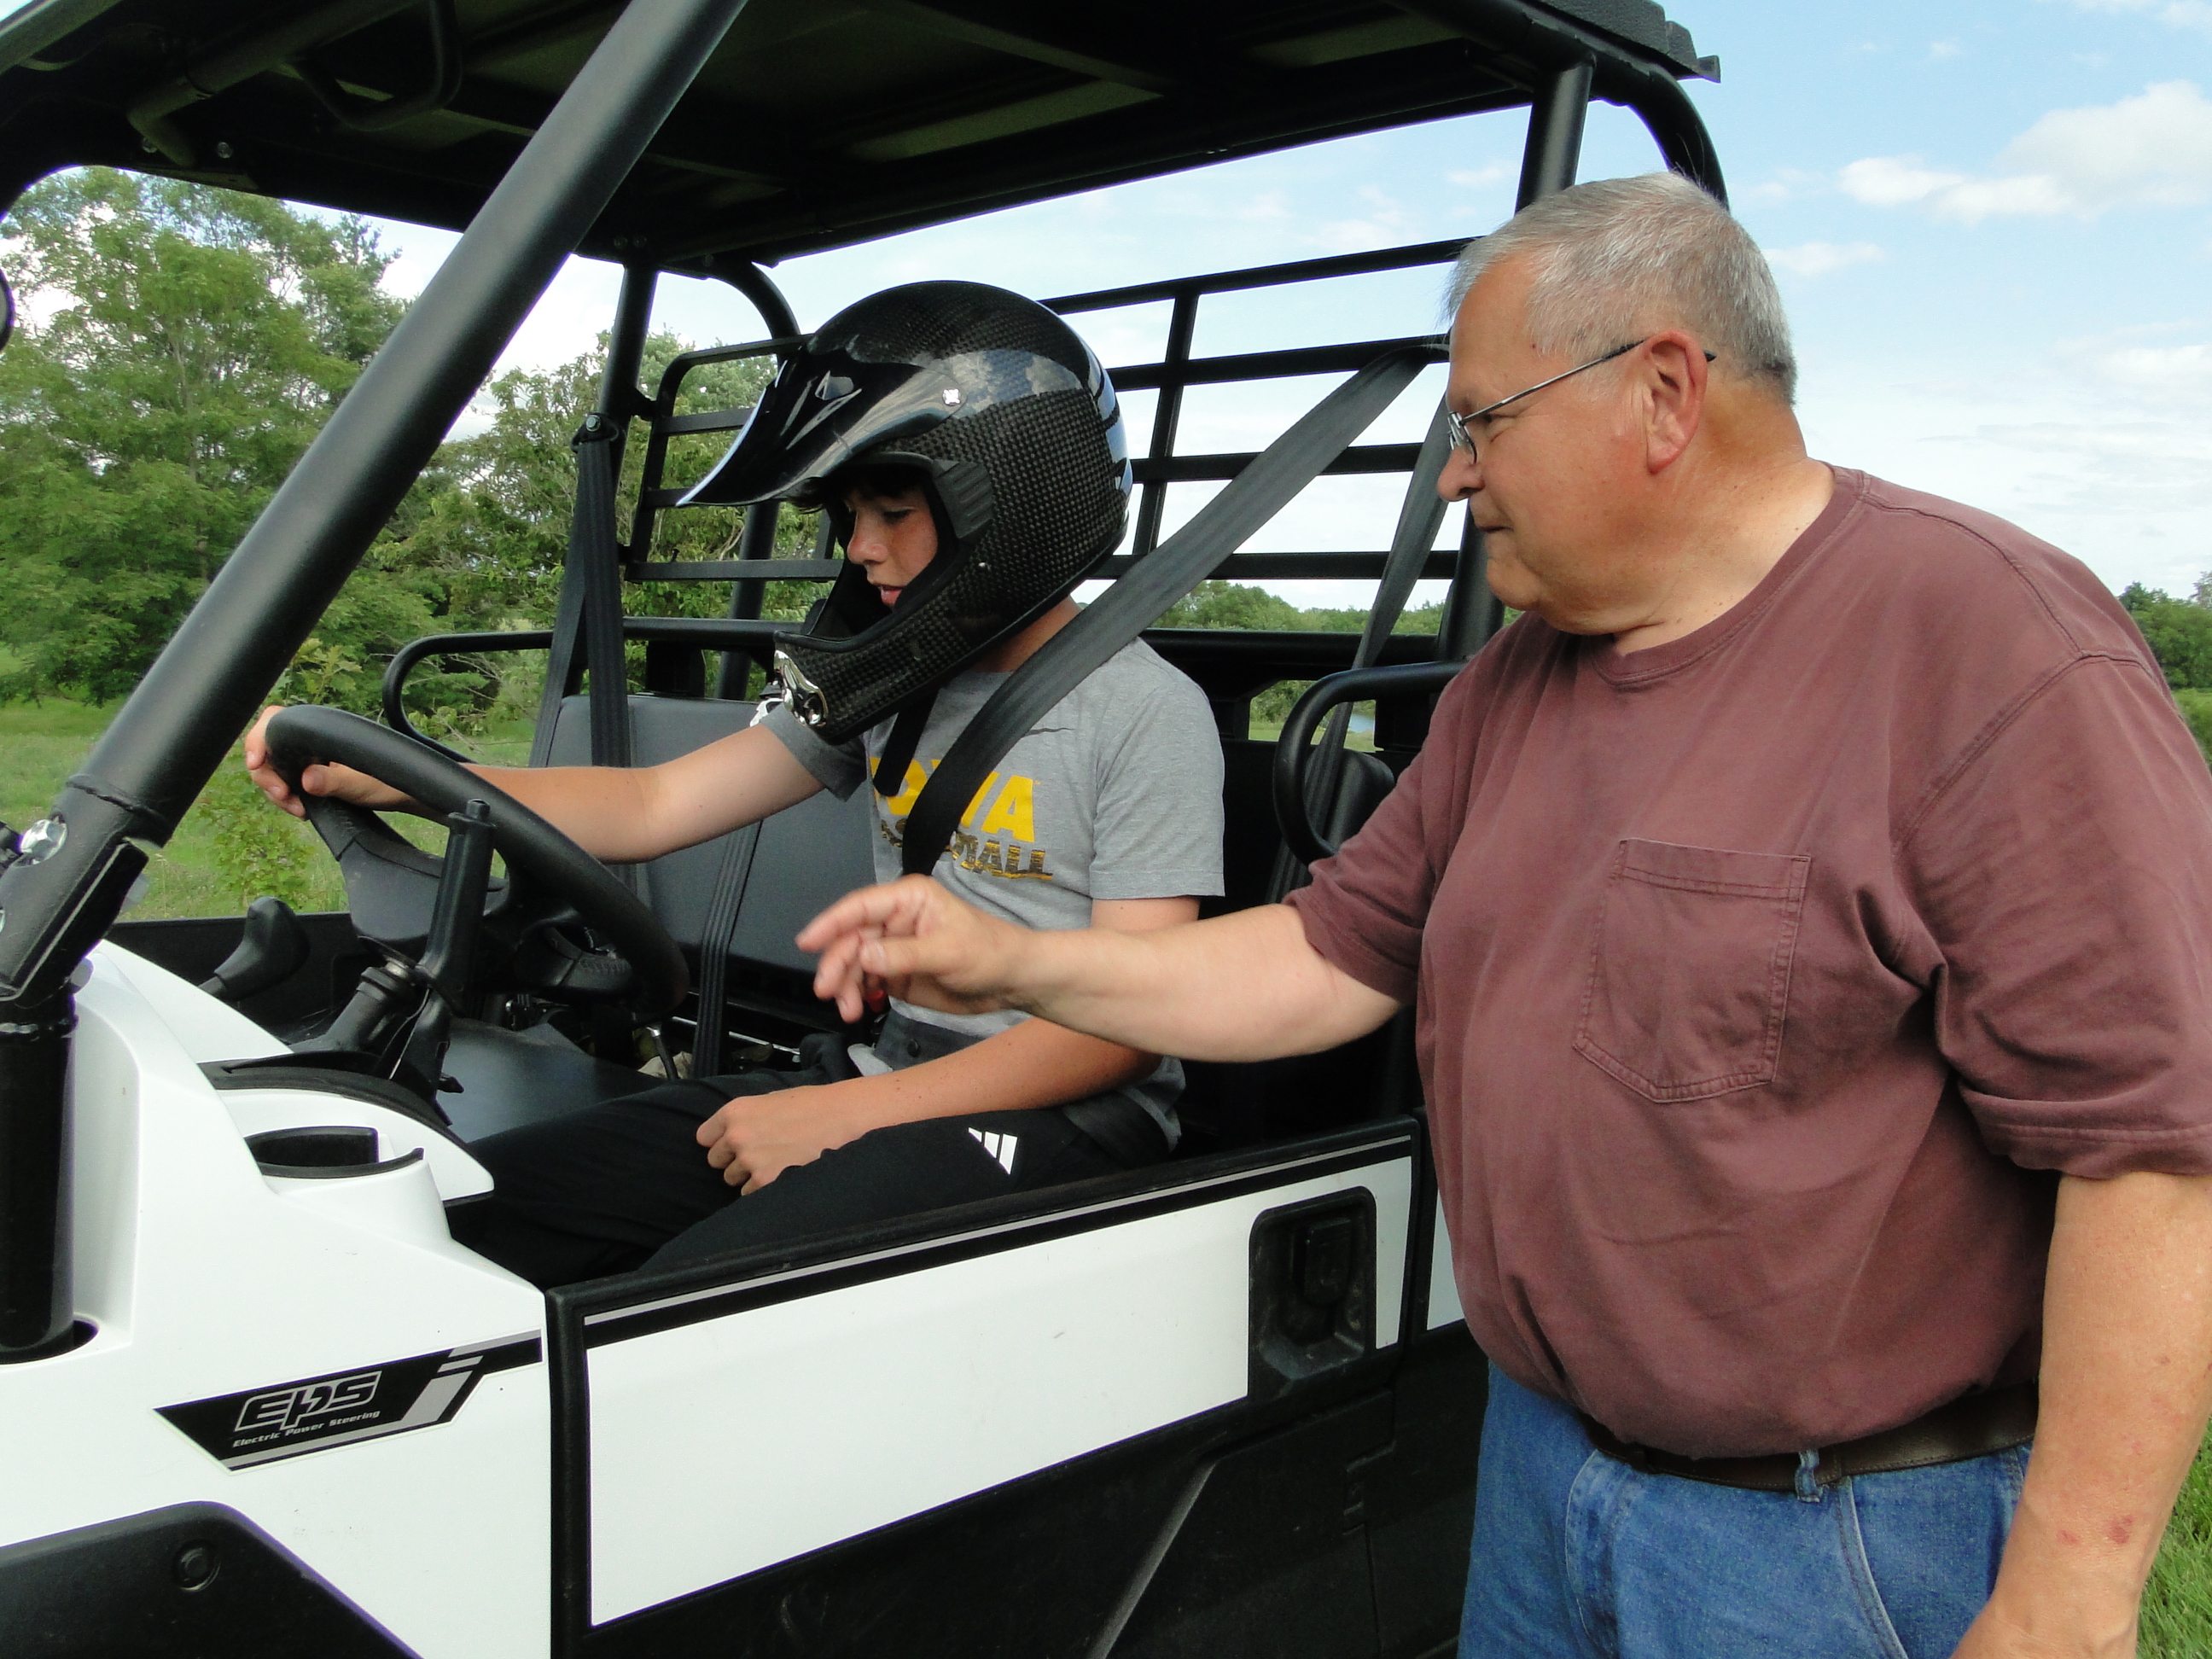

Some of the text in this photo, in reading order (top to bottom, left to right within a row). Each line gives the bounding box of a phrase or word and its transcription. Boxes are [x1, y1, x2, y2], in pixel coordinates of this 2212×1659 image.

[234, 1371, 382, 1432] EPS
[233, 1411, 381, 1448] Electric Power Steering
